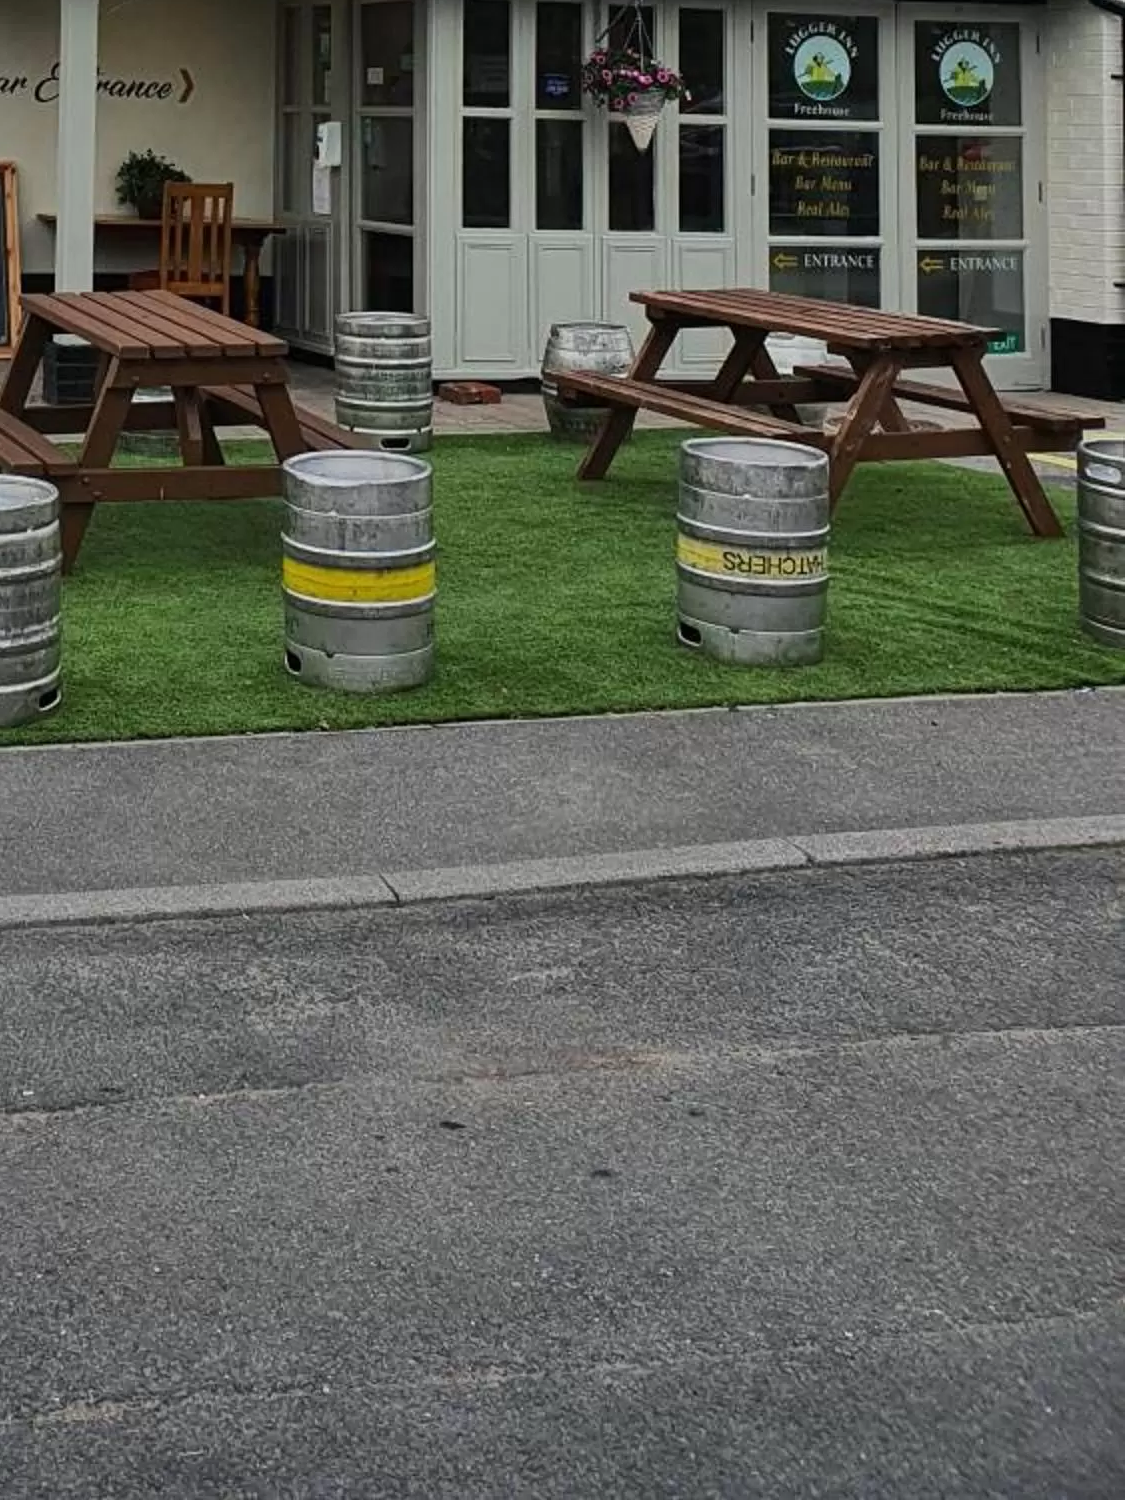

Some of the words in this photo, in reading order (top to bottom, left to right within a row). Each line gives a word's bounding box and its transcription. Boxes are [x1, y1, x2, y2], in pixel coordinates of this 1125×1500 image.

[34, 61, 173, 103] Erance
[795, 103, 851, 116] Freehouse
[803, 254, 874, 268] ENTRANCE
[950, 257, 1018, 271] ENTRANCE
